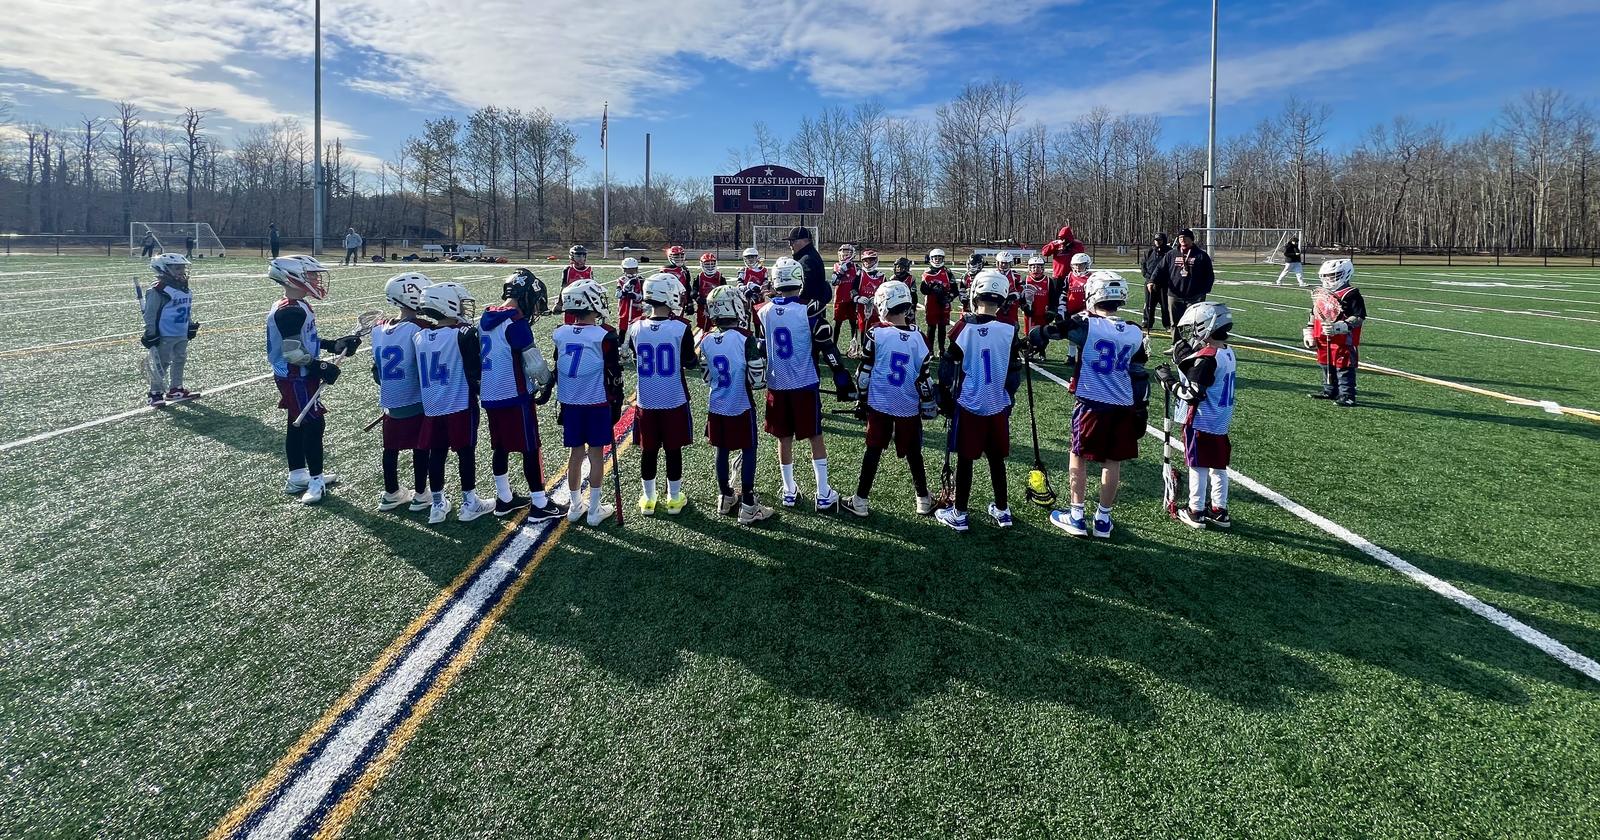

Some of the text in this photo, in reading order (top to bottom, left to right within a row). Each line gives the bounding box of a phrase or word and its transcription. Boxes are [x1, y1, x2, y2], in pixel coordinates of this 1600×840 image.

[720, 176, 744, 184] TOWN
[778, 177, 818, 185] HAMPTON
[722, 188, 742, 196] HOME
[796, 189, 817, 197] GUEST
[402, 283, 414, 293] 12
[565, 342, 584, 378] 7
[637, 342, 676, 378] 30
[773, 326, 794, 360] 9
[827, 353, 839, 367] STX
[1091, 339, 1133, 375] 34
[420, 351, 451, 388] 14
[713, 354, 732, 389] 3
[886, 350, 910, 387] 5
[980, 348, 992, 385] 1
